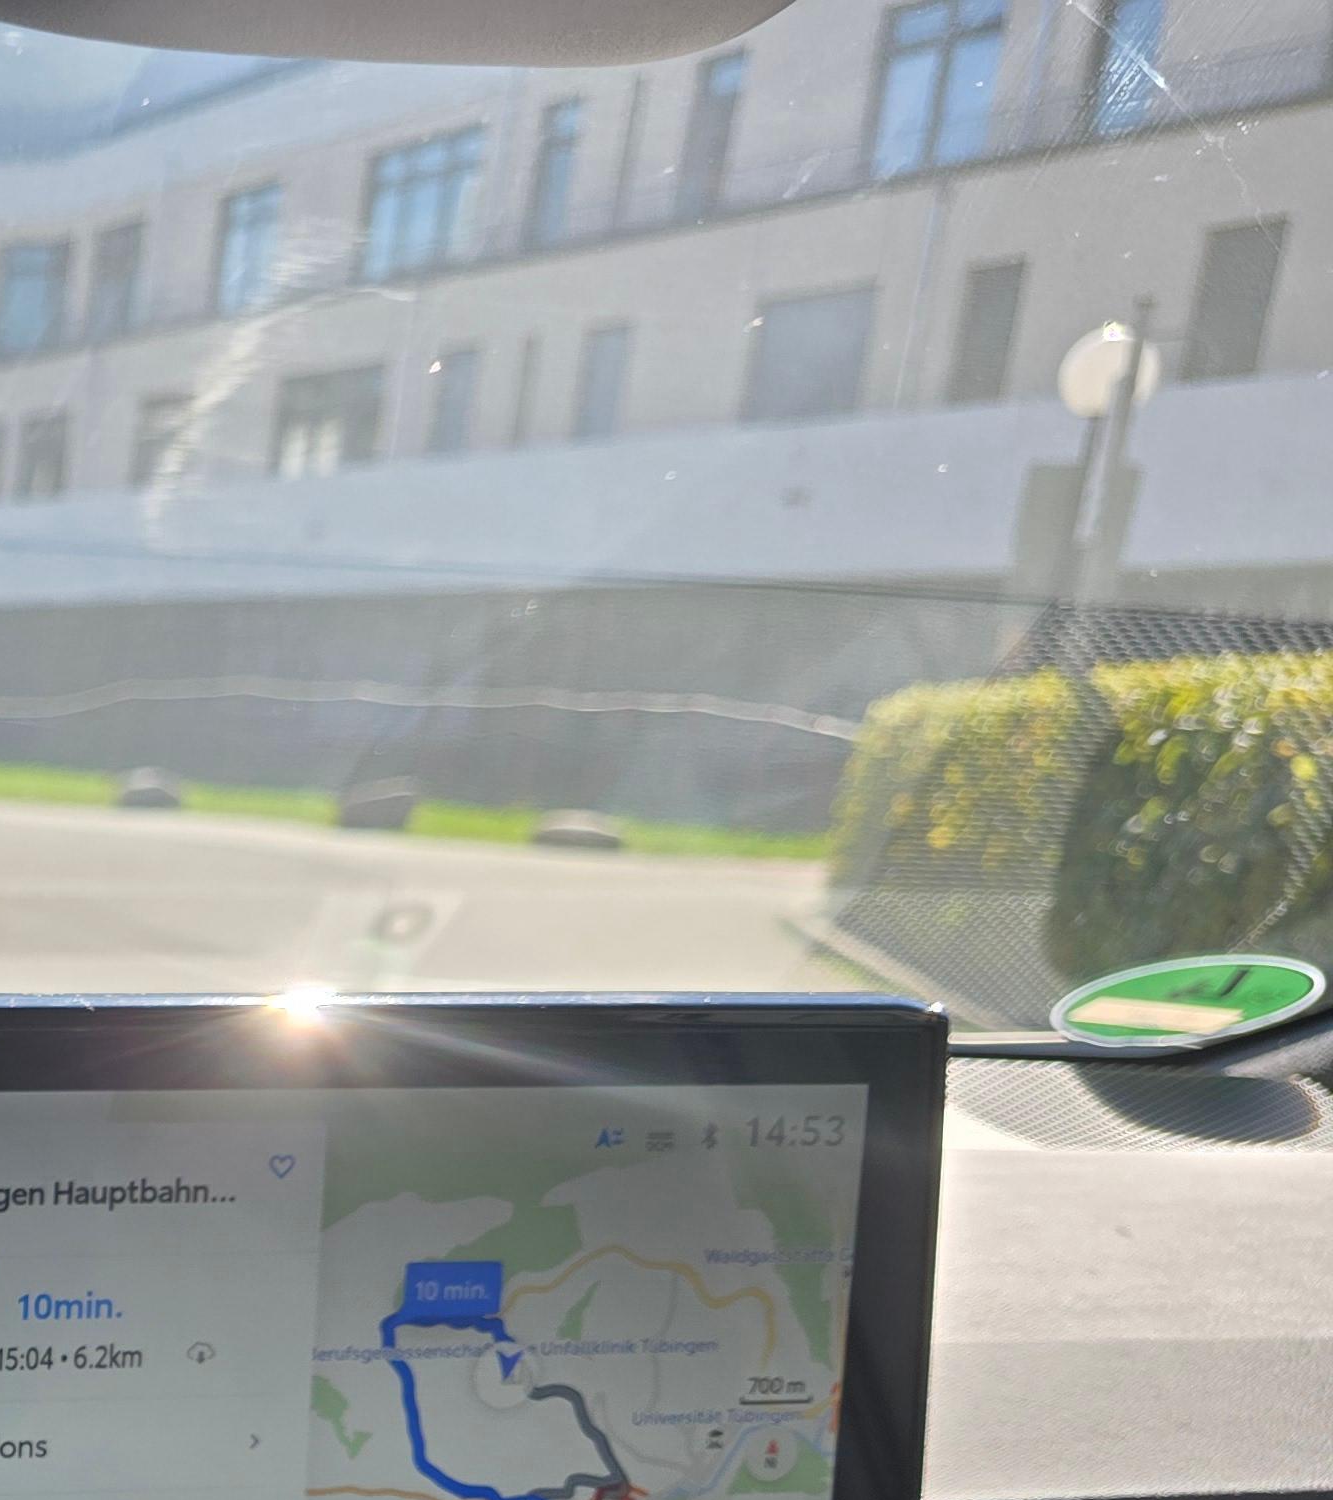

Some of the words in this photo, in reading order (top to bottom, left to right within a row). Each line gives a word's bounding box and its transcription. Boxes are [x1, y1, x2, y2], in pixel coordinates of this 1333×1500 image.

[746, 1115, 846, 1148] 14:53
[52, 1177, 237, 1211] Hauptbahn...
[415, 1281, 437, 1301] 10
[443, 1280, 489, 1301] min.
[17, 1292, 124, 1322] 10min.
[748, 1376, 783, 1395] 700
[786, 1379, 806, 1394] m
